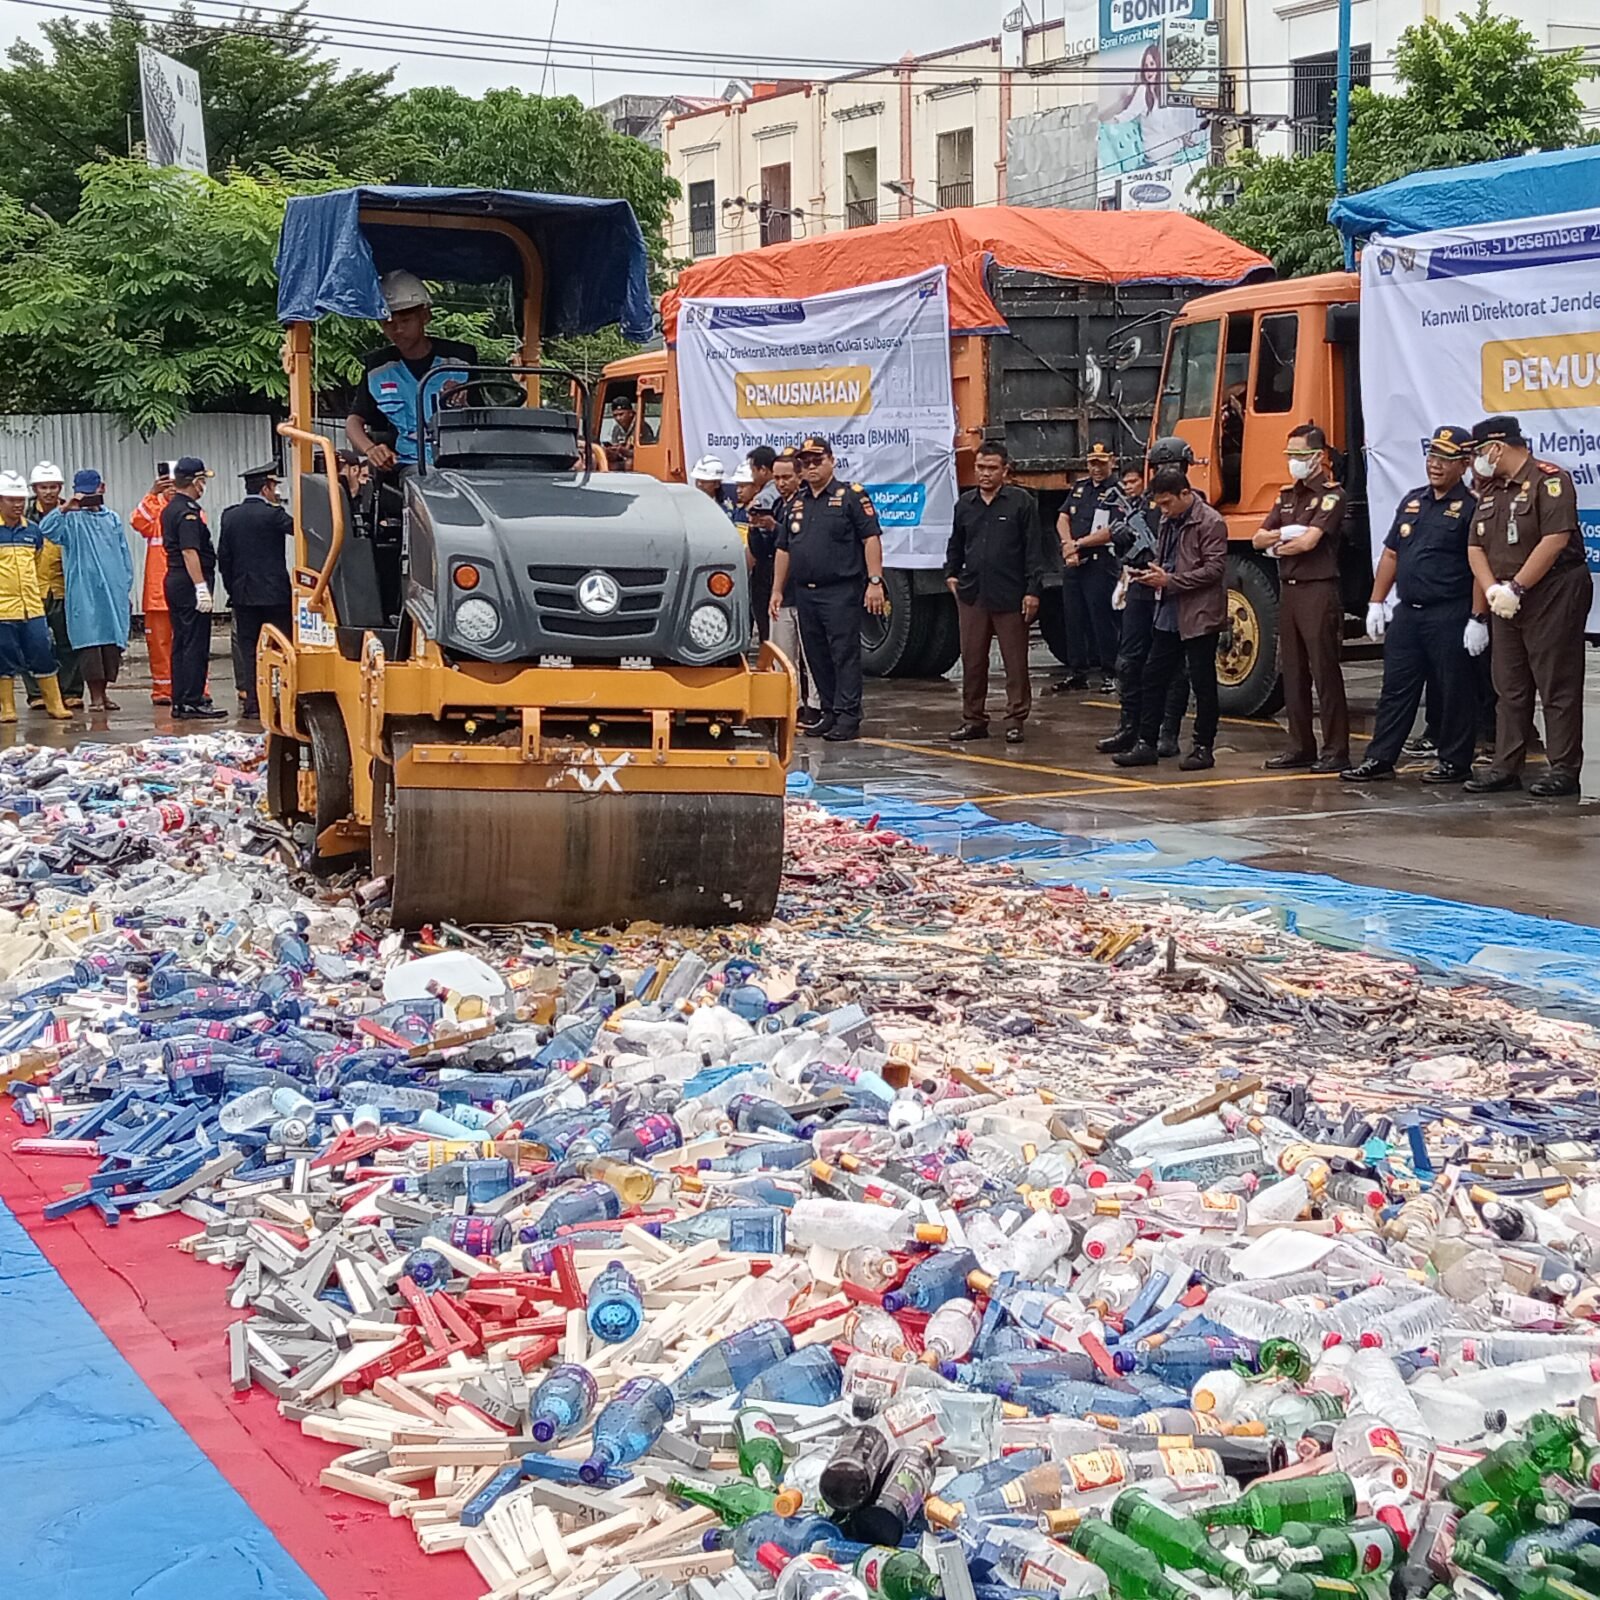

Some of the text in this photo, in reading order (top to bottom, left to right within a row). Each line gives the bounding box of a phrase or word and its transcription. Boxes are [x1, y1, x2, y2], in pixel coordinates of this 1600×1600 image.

[1443, 243, 1491, 259] Kamis,
[1492, 240, 1501, 254] 5
[1505, 227, 1587, 252] Desember
[1421, 291, 1600, 327] Kanwil Direktorat Jende
[800, 343, 817, 355] Bea
[818, 342, 835, 354] dan
[836, 337, 862, 353] Cukai
[1503, 354, 1600, 392] PEMU
[746, 381, 860, 406] PEMUSNAHAN
[708, 433, 739, 449] Barang
[741, 432, 762, 446] Yang
[765, 431, 802, 447] Menjadi
[828, 431, 865, 449] Negara
[868, 428, 910, 448] (BMMN)
[482, 1397, 502, 1417] 212
